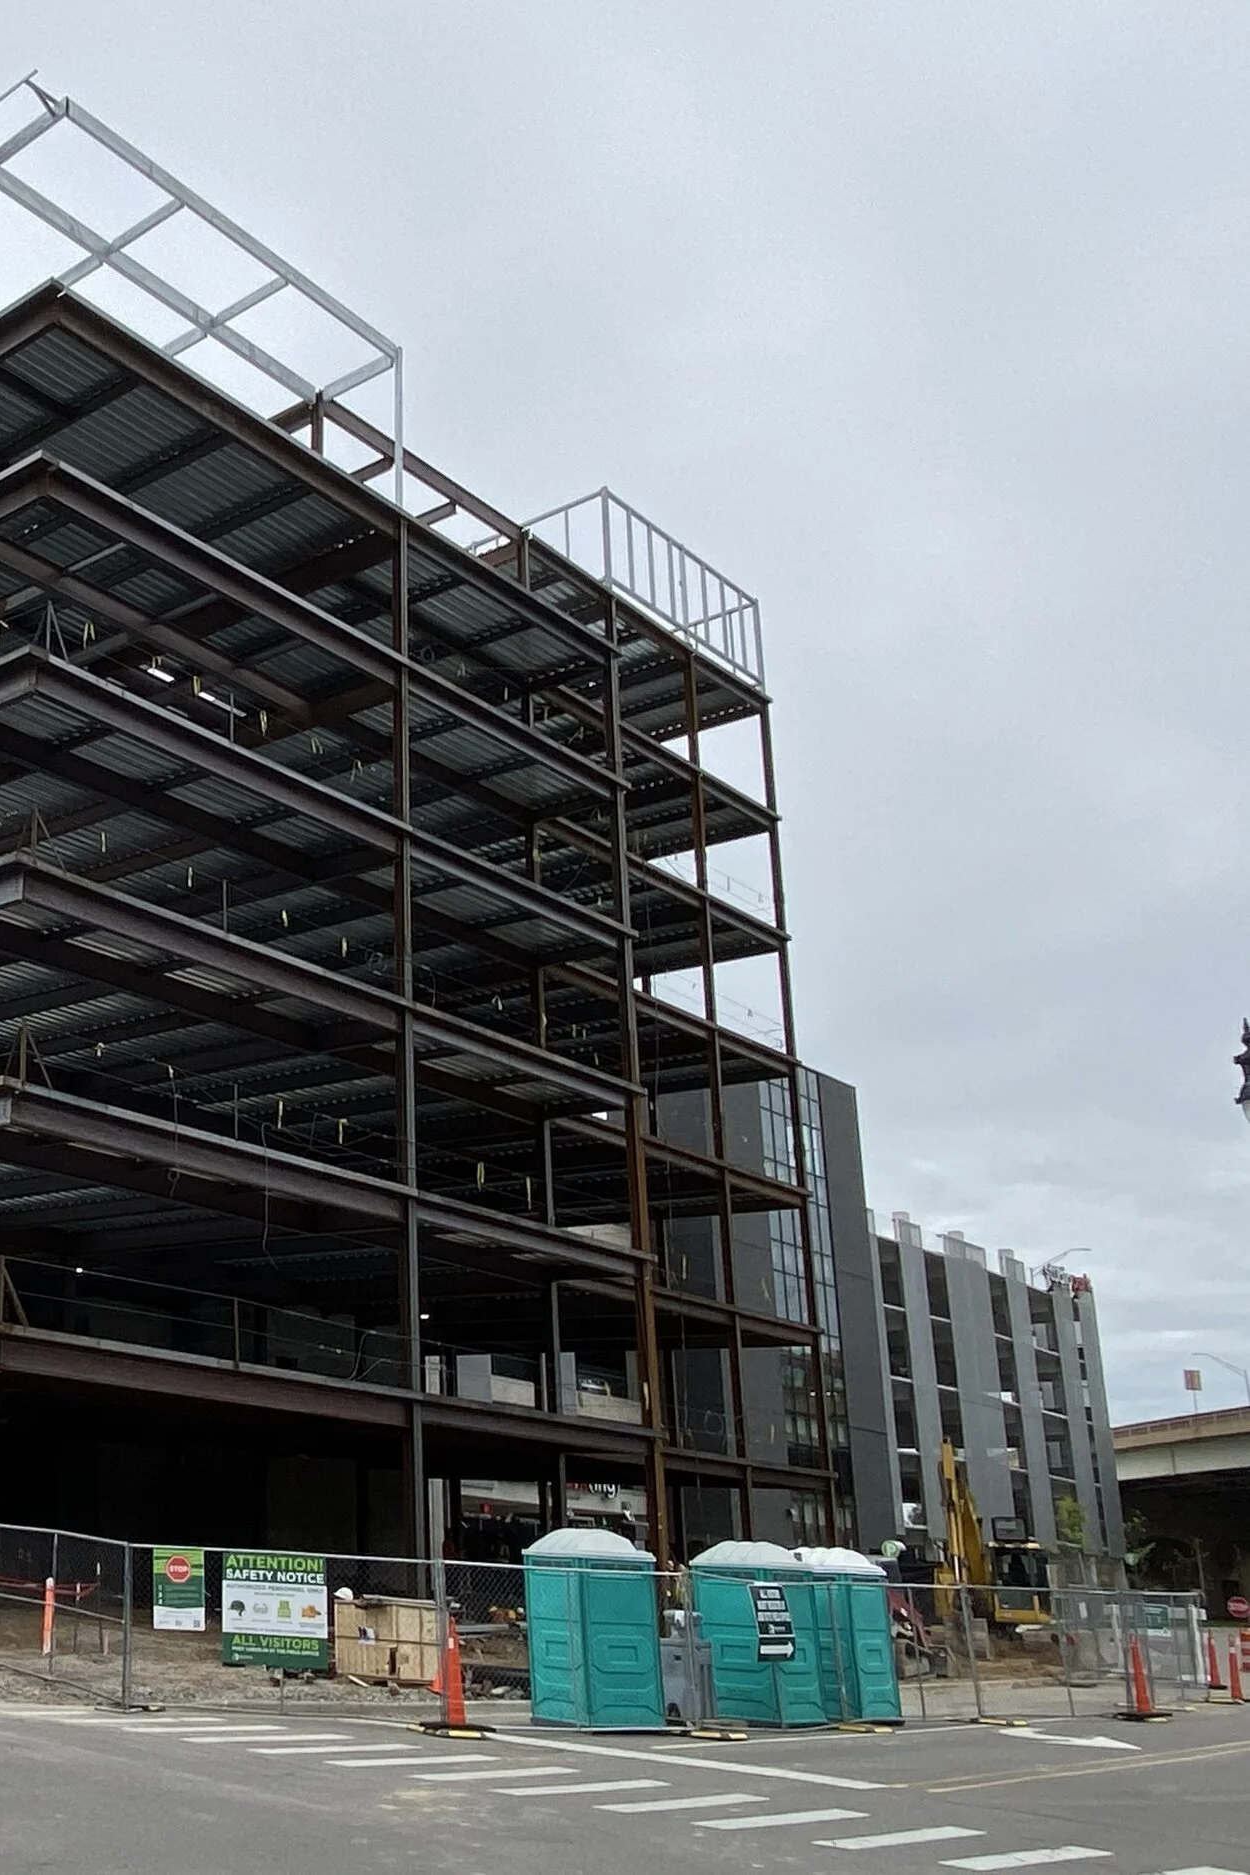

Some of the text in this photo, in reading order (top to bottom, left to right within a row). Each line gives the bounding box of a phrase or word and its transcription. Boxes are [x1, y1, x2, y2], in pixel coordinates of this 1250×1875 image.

[169, 1565, 188, 1573] STOP
[226, 1554, 324, 1571] ATTENTION!
[225, 1568, 325, 1584] SAFETY NOTICE
[232, 1634, 319, 1650] ALL VISITORS
